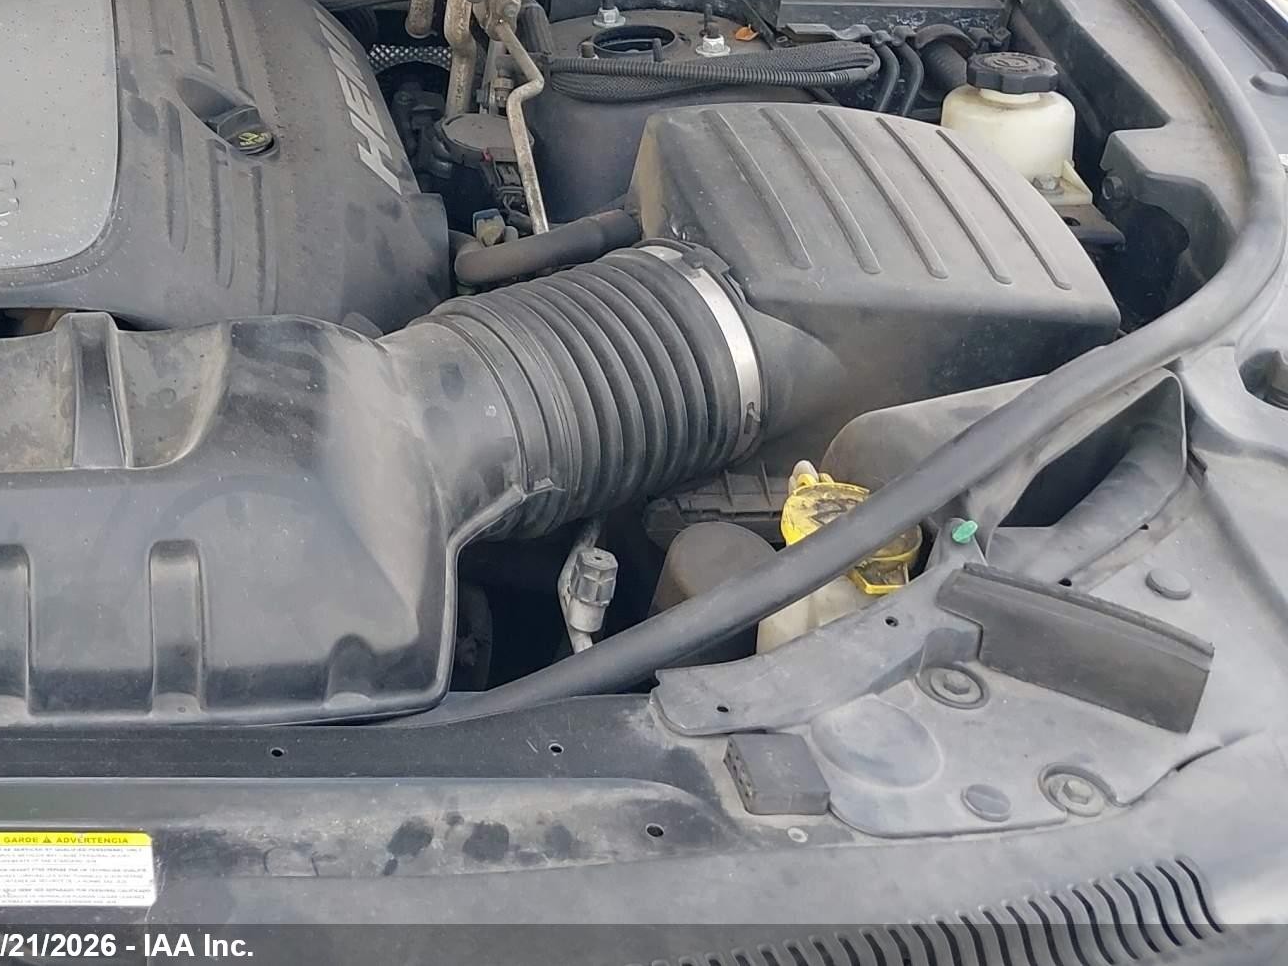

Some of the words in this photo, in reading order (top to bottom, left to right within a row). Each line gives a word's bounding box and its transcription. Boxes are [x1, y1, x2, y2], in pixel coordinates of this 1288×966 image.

[313, 8, 402, 195] HEMI
[3, 836, 39, 844] GARDE
[56, 836, 129, 844] ADVERTENCIA
